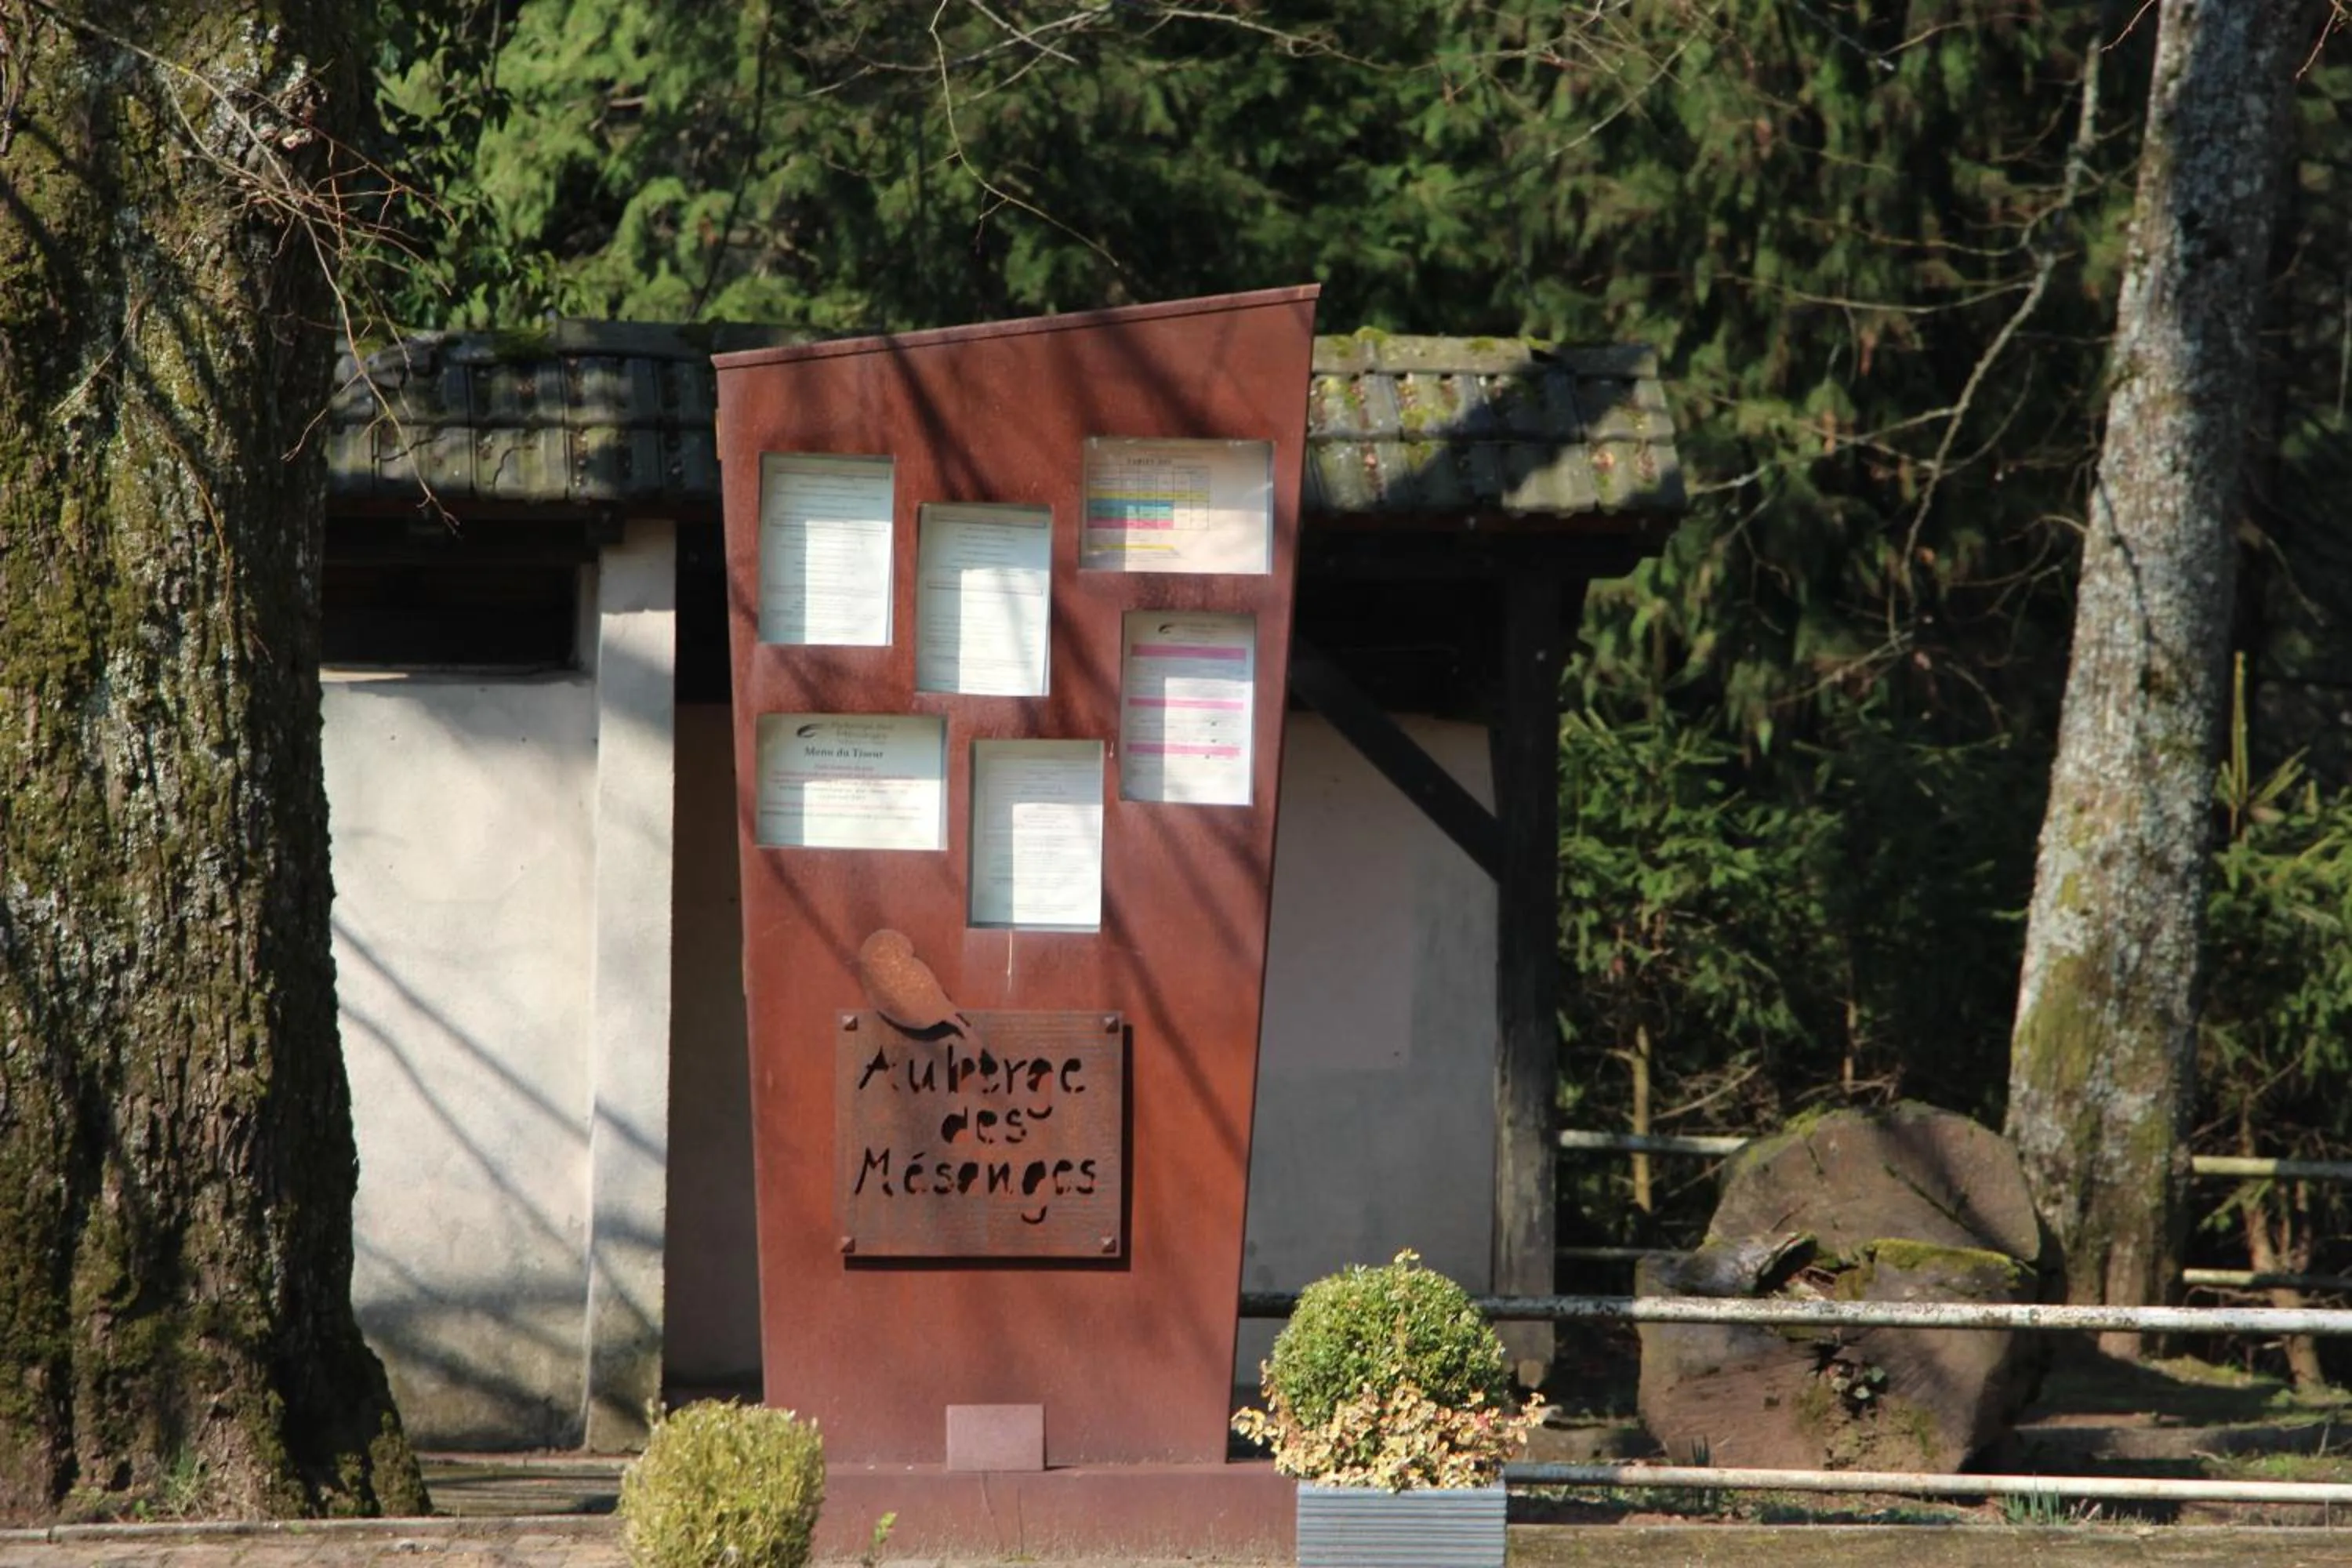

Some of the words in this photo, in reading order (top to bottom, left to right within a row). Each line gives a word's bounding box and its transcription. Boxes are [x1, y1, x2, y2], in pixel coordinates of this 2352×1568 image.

[804, 746, 833, 758] Menu
[836, 748, 849, 758] du
[858, 1043, 1086, 1120] Auberge
[941, 1106, 1028, 1145] des
[855, 1147, 1097, 1225] Mésanges
